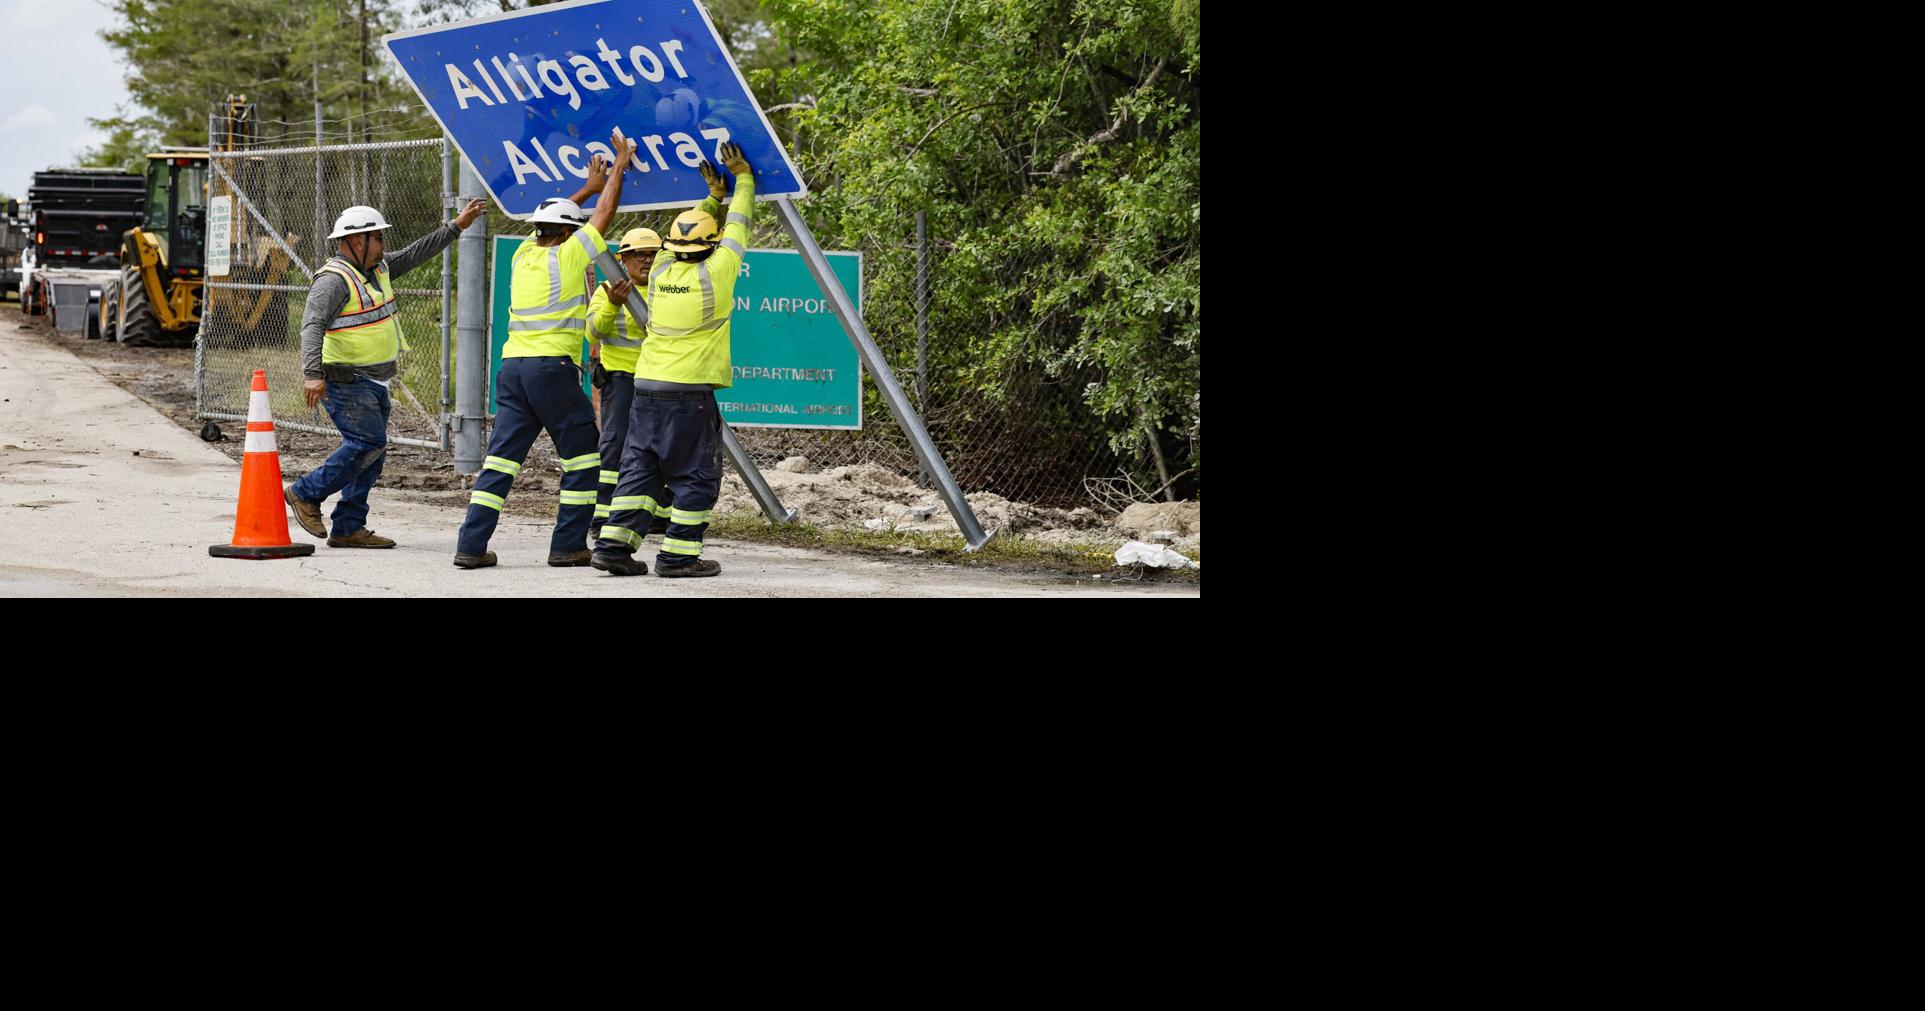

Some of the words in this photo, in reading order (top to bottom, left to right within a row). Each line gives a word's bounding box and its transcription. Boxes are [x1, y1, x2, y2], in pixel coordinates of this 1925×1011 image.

[445, 38, 688, 111] Alligator
[659, 284, 691, 294] webber
[759, 297, 833, 315] AIRPOR
[731, 366, 836, 380] DEPARTMENT
[718, 402, 798, 415] TERNATIONAL
